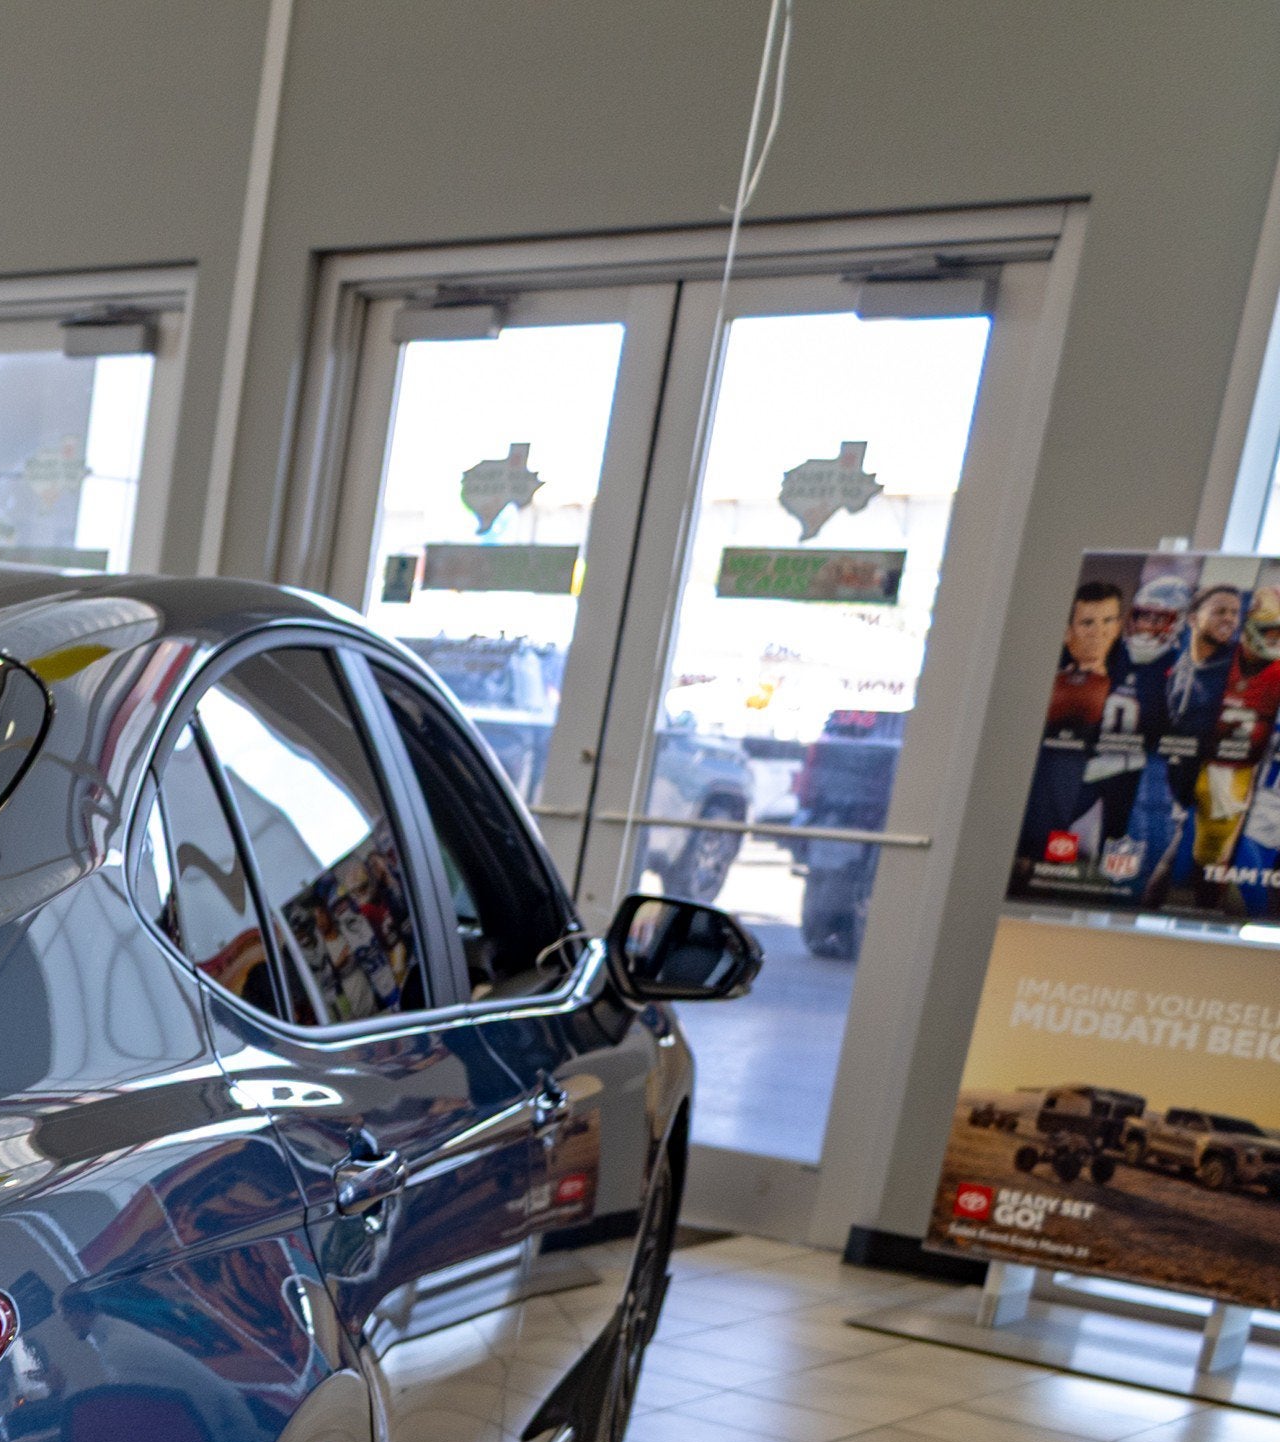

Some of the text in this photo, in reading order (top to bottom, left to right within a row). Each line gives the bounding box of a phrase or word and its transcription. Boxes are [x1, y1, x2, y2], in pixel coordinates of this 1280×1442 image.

[1203, 865, 1258, 884] TEAM
[1017, 978, 1280, 1029] IMAGINE YOURSEL
[1009, 1001, 1201, 1051] MUDBATH
[994, 1203, 1046, 1232] GO!
[997, 1188, 1097, 1221] READY SET
